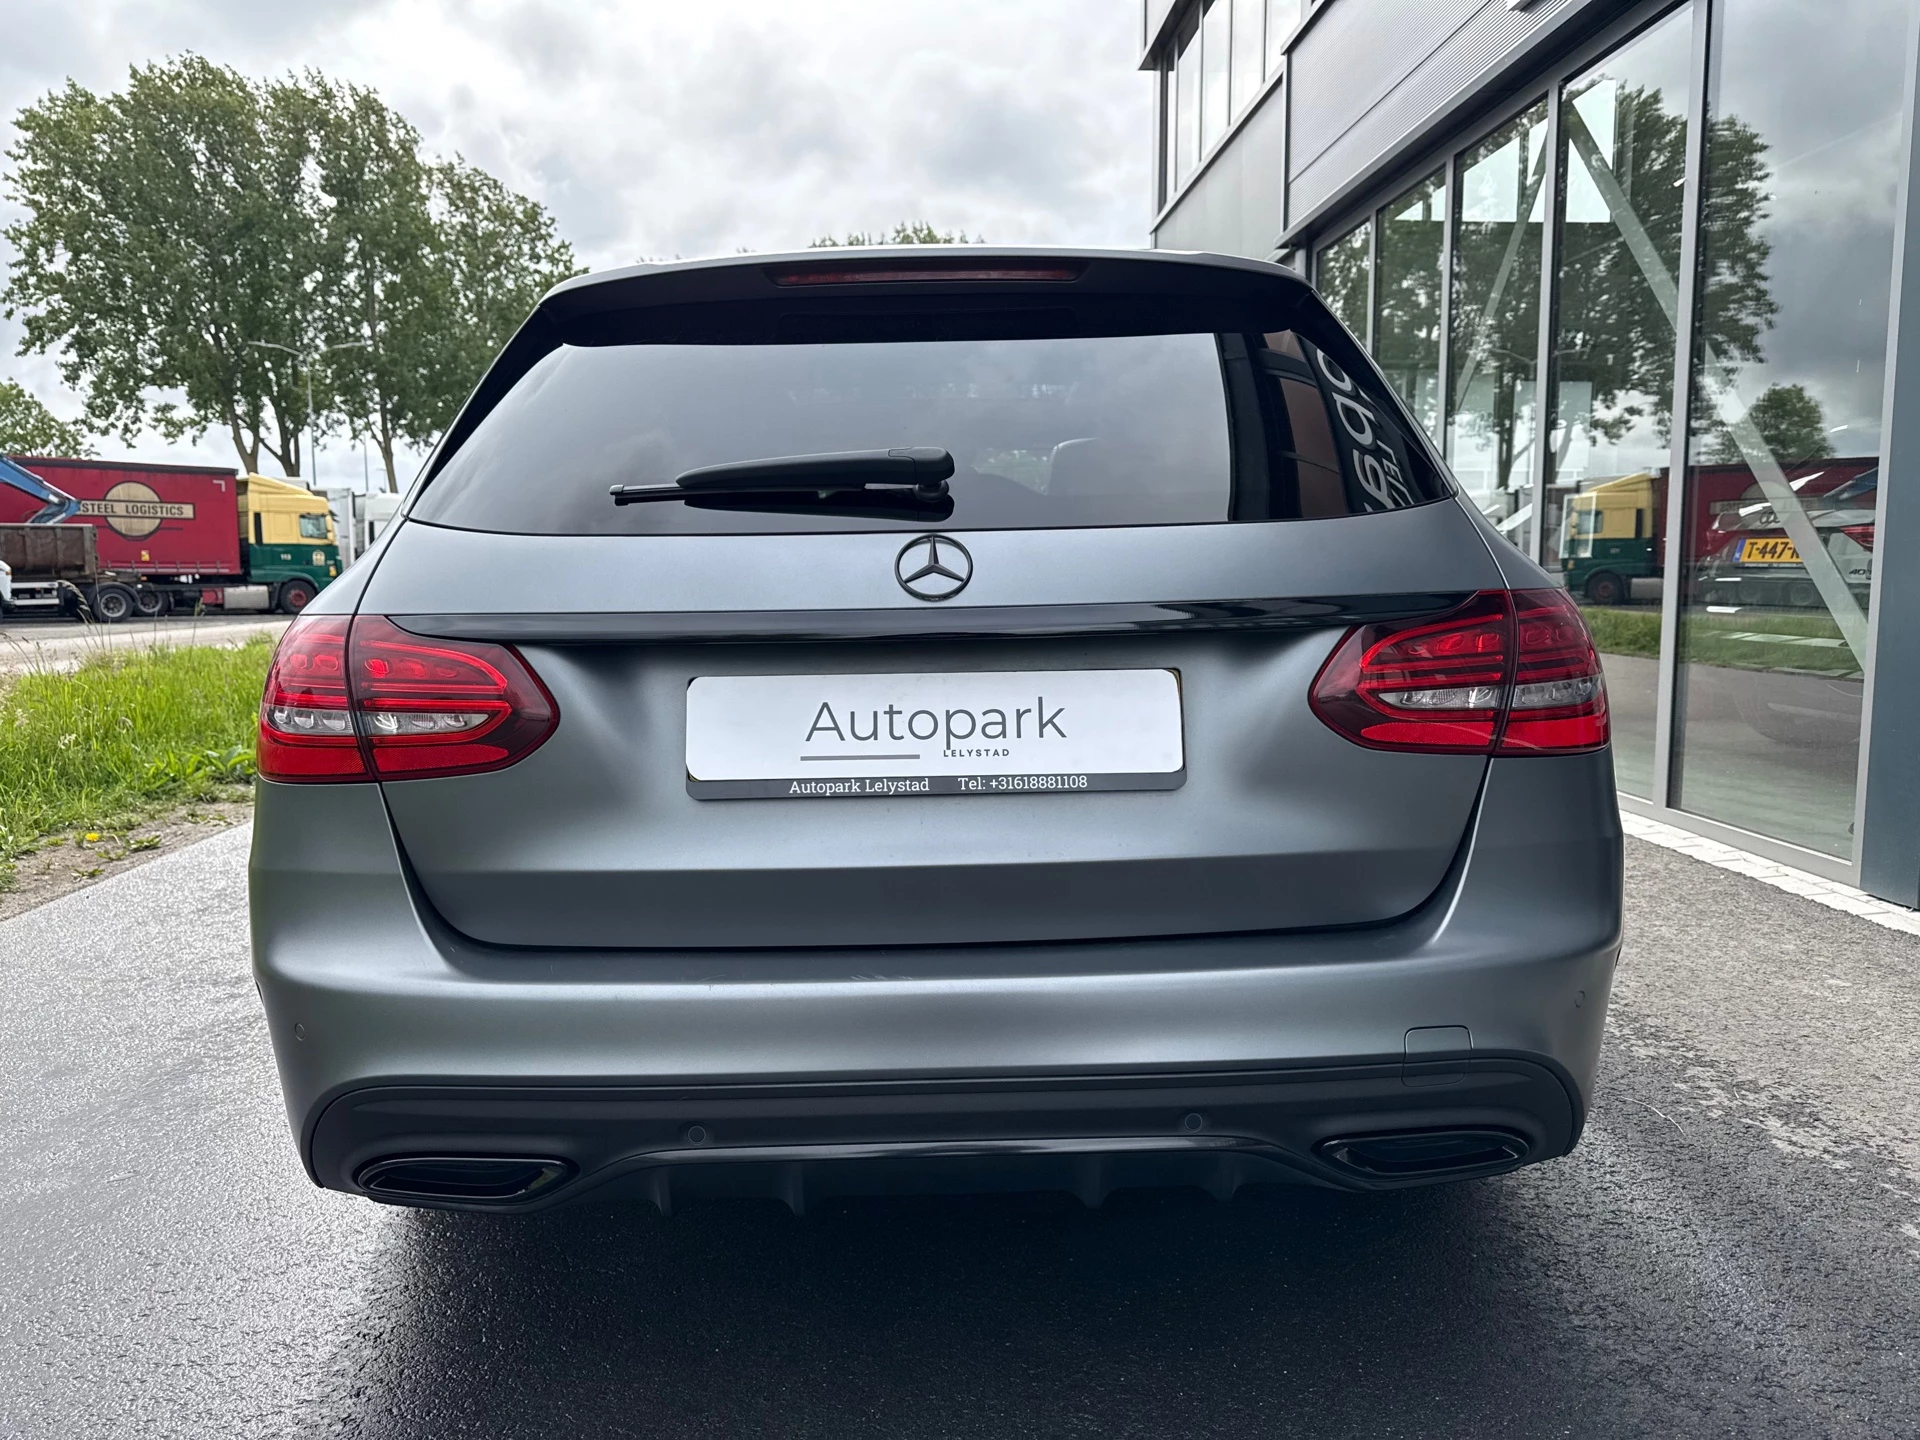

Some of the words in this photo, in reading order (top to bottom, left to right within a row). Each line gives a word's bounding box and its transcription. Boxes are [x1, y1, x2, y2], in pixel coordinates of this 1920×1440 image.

[81, 502, 117, 514] STEEL
[125, 504, 184, 516] LOGISTICS
[805, 696, 1067, 750] Autopark
[943, 748, 1010, 757] LELYSTAD
[789, 778, 861, 796] Autopark
[865, 777, 930, 795] Lelystad
[957, 776, 986, 790] Tel:
[989, 775, 1088, 790] +31618881108
